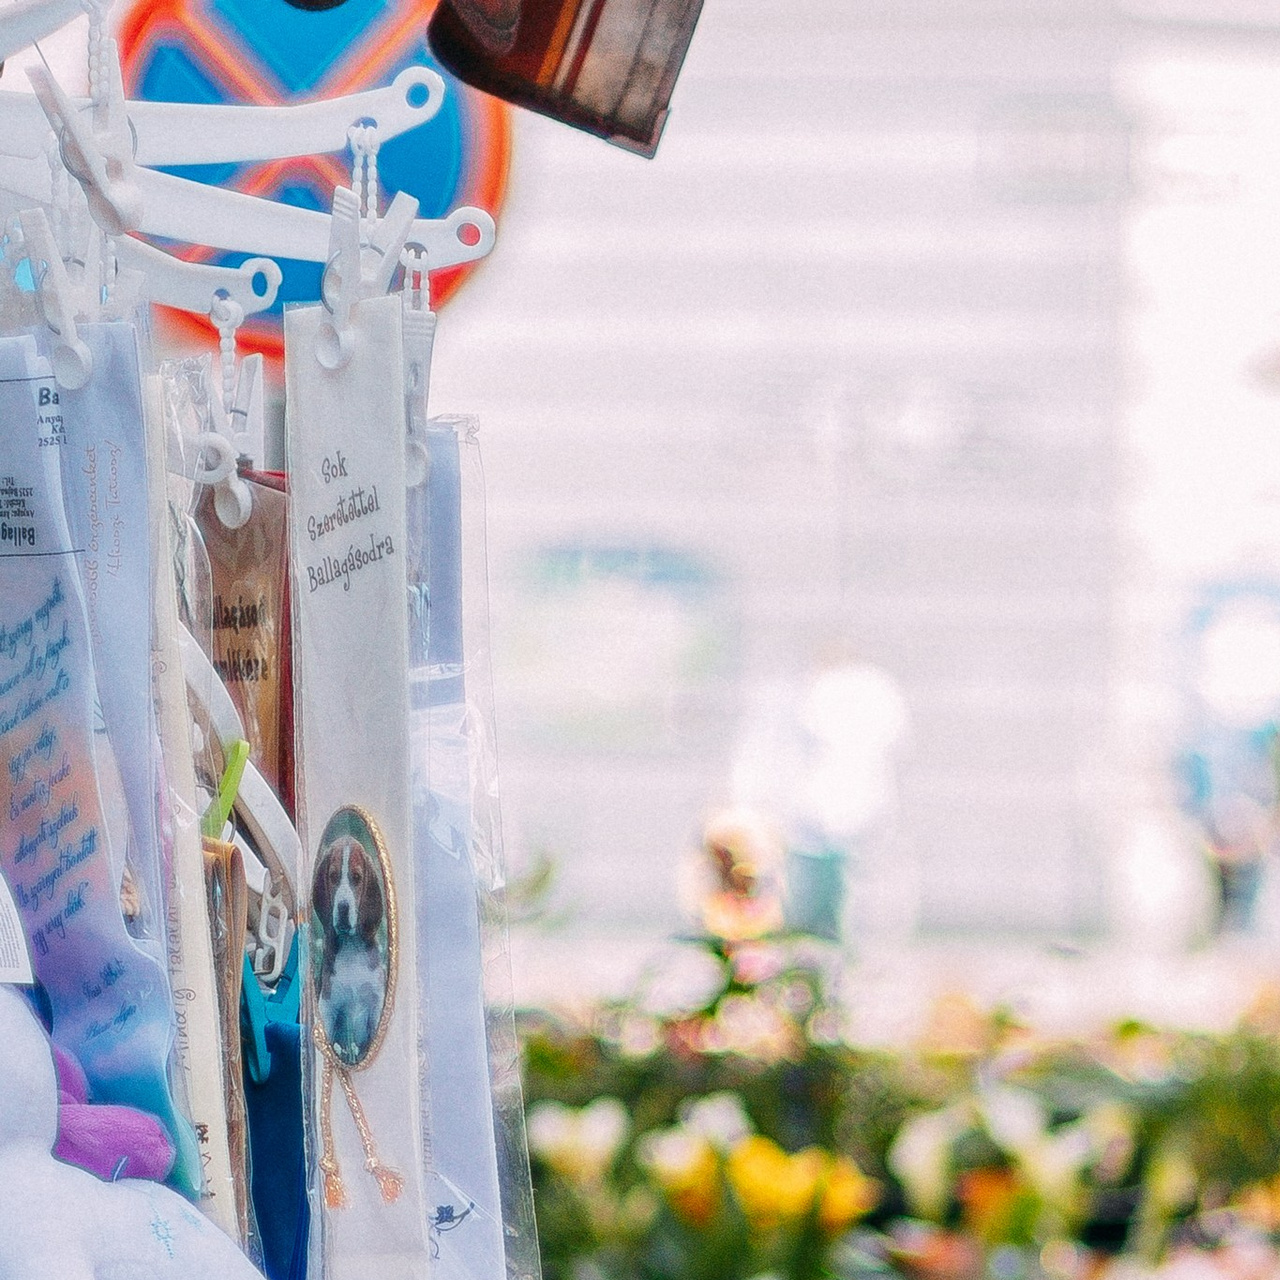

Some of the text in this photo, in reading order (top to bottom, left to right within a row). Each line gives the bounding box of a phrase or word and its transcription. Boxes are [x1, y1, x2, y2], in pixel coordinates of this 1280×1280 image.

[322, 451, 348, 483] Sok
[307, 485, 380, 541] Szeretettel
[307, 533, 395, 593] Ballagásodra
